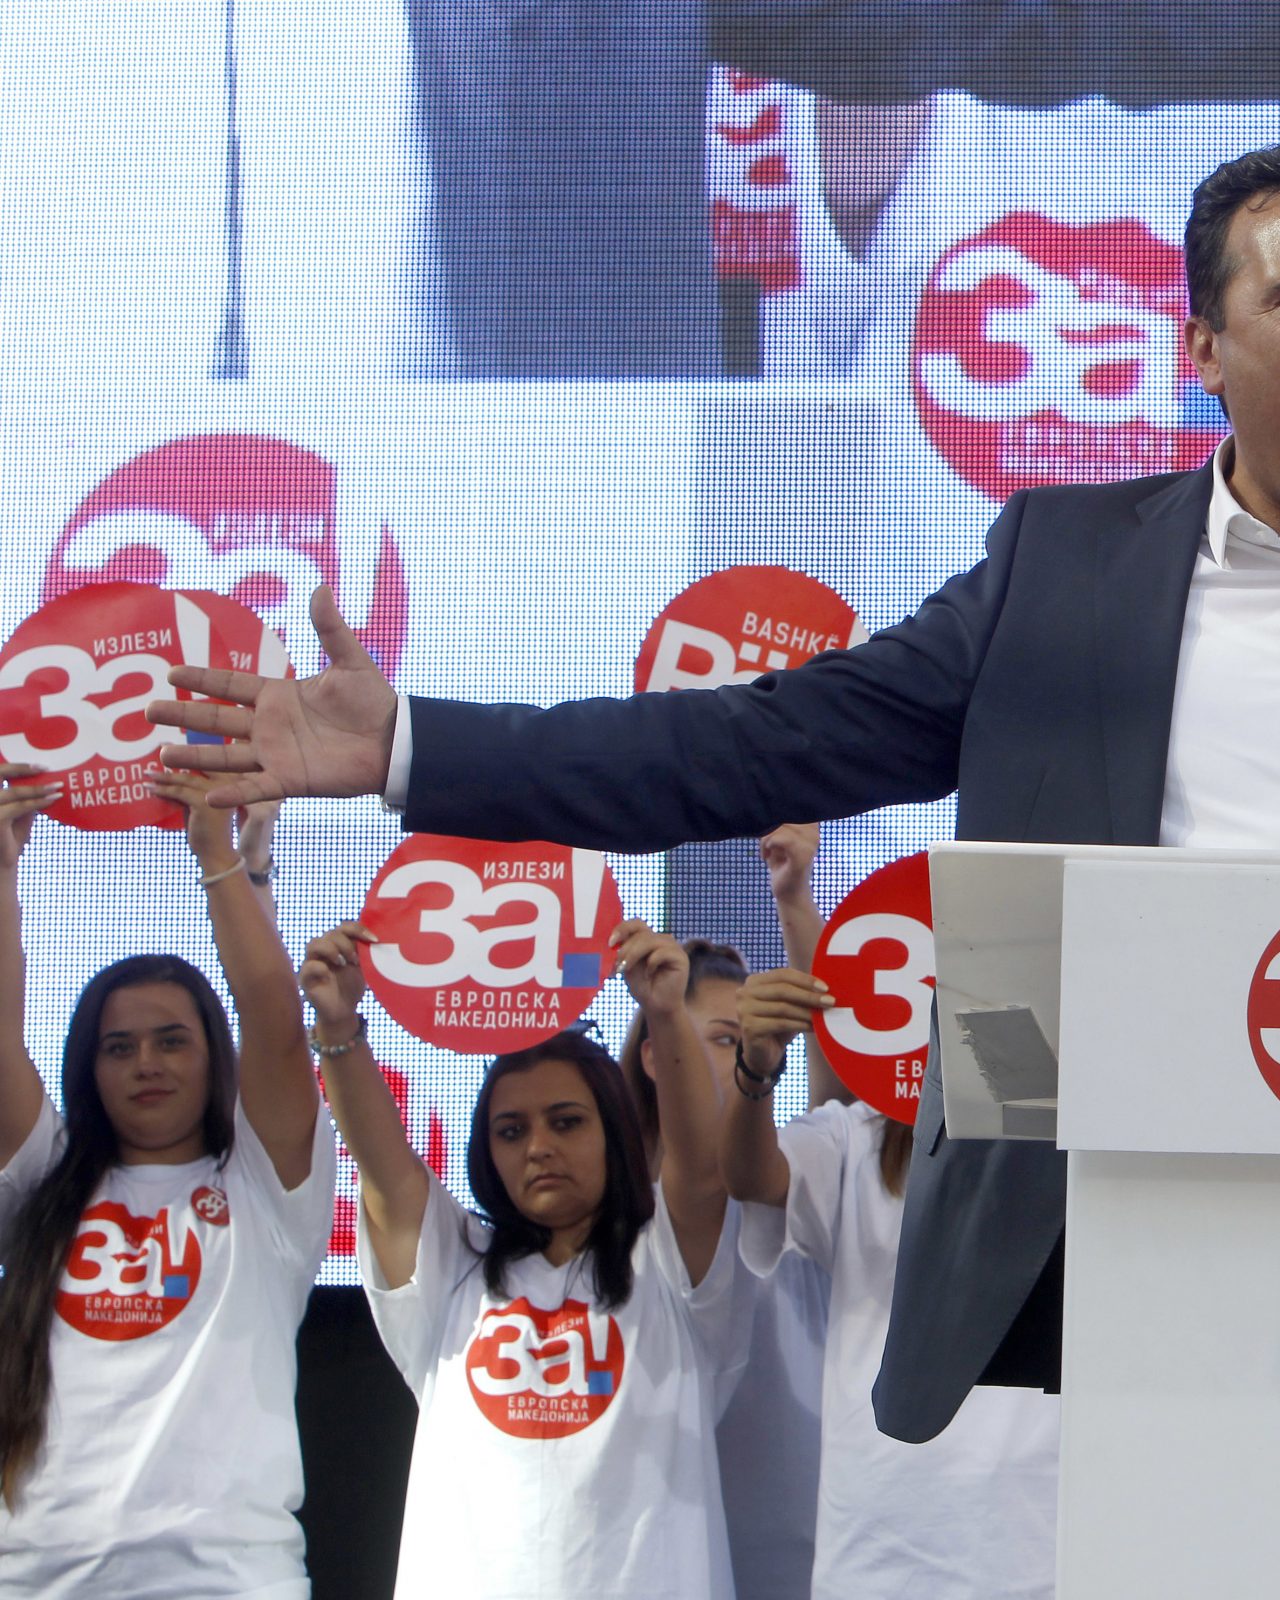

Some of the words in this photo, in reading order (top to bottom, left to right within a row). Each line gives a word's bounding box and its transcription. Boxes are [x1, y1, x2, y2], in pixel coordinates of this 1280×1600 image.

[920, 246, 1184, 428] За
[93, 628, 173, 657] ИЗЛЕЗИ
[68, 760, 190, 790] ЕВРОП
[70, 783, 153, 809] МАКЕДО
[484, 861, 565, 880] ИЗЛЕЗИ
[435, 990, 561, 1009] ЕВРОПСКА
[433, 1010, 560, 1029] МАКЕДОНИЈА
[85, 1296, 163, 1311] ЕВРОПСКА
[84, 1310, 163, 1324] МАКЕДОНИЈА
[508, 1395, 589, 1409] ЕВРОПСКА
[508, 1408, 590, 1423] МАКЕДОНИЈА
